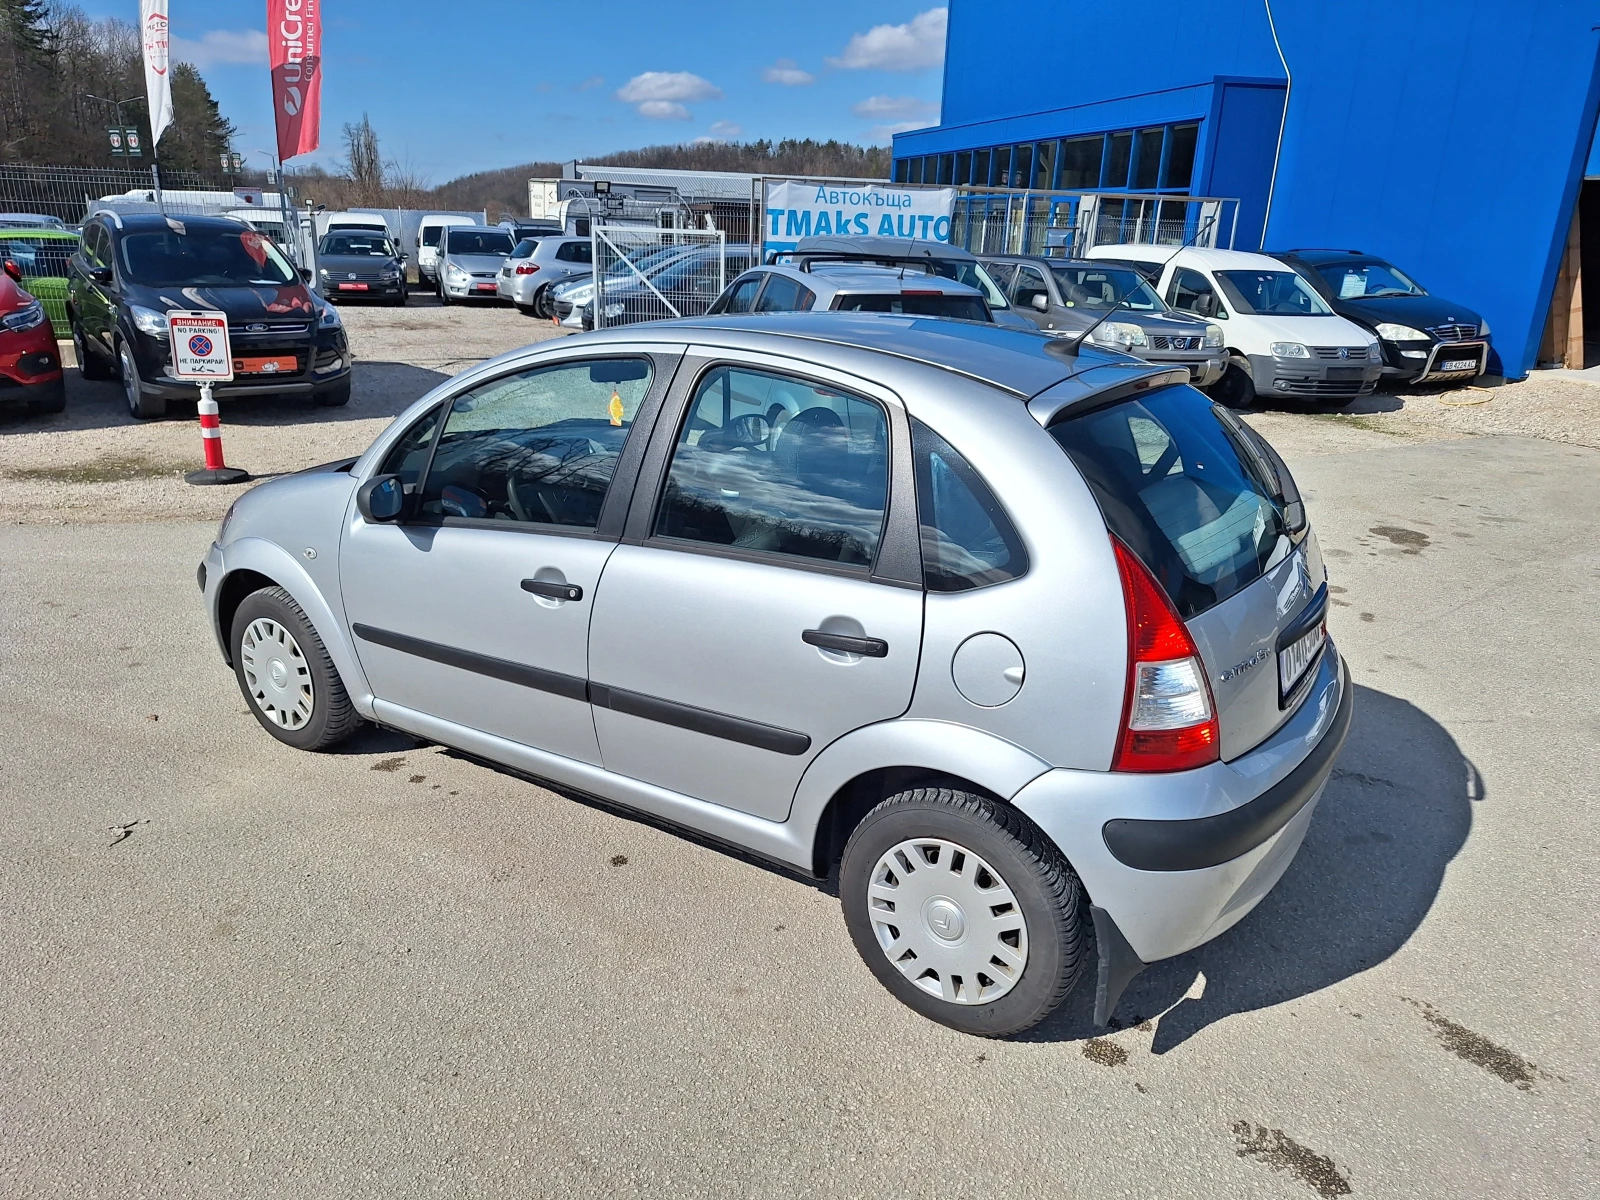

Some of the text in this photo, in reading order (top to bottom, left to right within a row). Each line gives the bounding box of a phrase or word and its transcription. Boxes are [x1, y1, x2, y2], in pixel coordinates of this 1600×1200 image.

[304, 21, 314, 82] Consumer
[815, 186, 912, 211] Автокъща
[767, 208, 950, 242] TMAkS AUTO
[176, 319, 219, 327] ВНИМАНИЕ!
[189, 327, 220, 335] PARKING!
